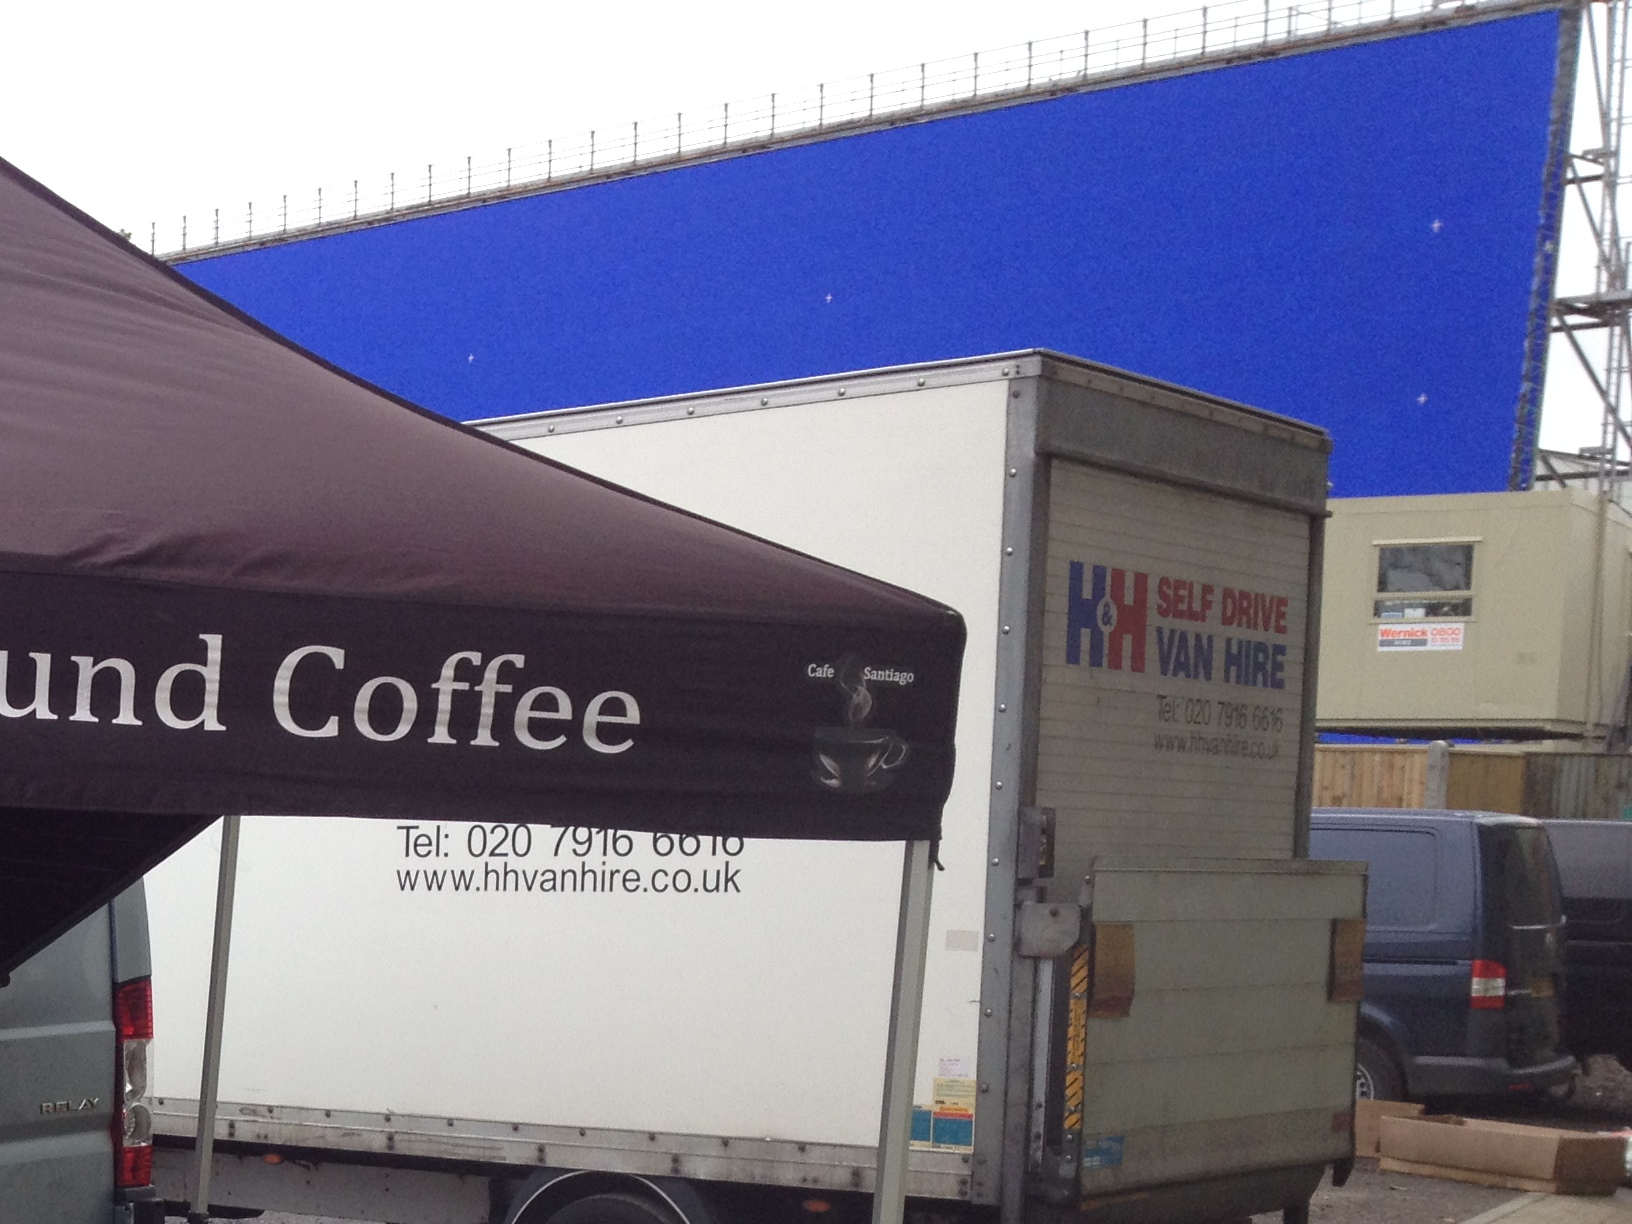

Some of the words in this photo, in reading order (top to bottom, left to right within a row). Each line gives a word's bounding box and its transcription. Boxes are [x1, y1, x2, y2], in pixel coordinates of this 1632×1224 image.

[1156, 576, 1215, 623] SELF
[1221, 587, 1289, 635] DRIVE
[807, 663, 835, 678] Cafe
[864, 666, 915, 685] Santiago
[1155, 626, 1215, 682] VAN
[1223, 637, 1287, 690] HIRE
[273, 645, 641, 754] Coffee
[1184, 698, 1212, 727] 020
[396, 825, 450, 857] Tel:
[467, 824, 532, 858] 020
[396, 861, 742, 894] www.hhvanhire.co.uk
[39, 1097, 99, 1115] RELAY
